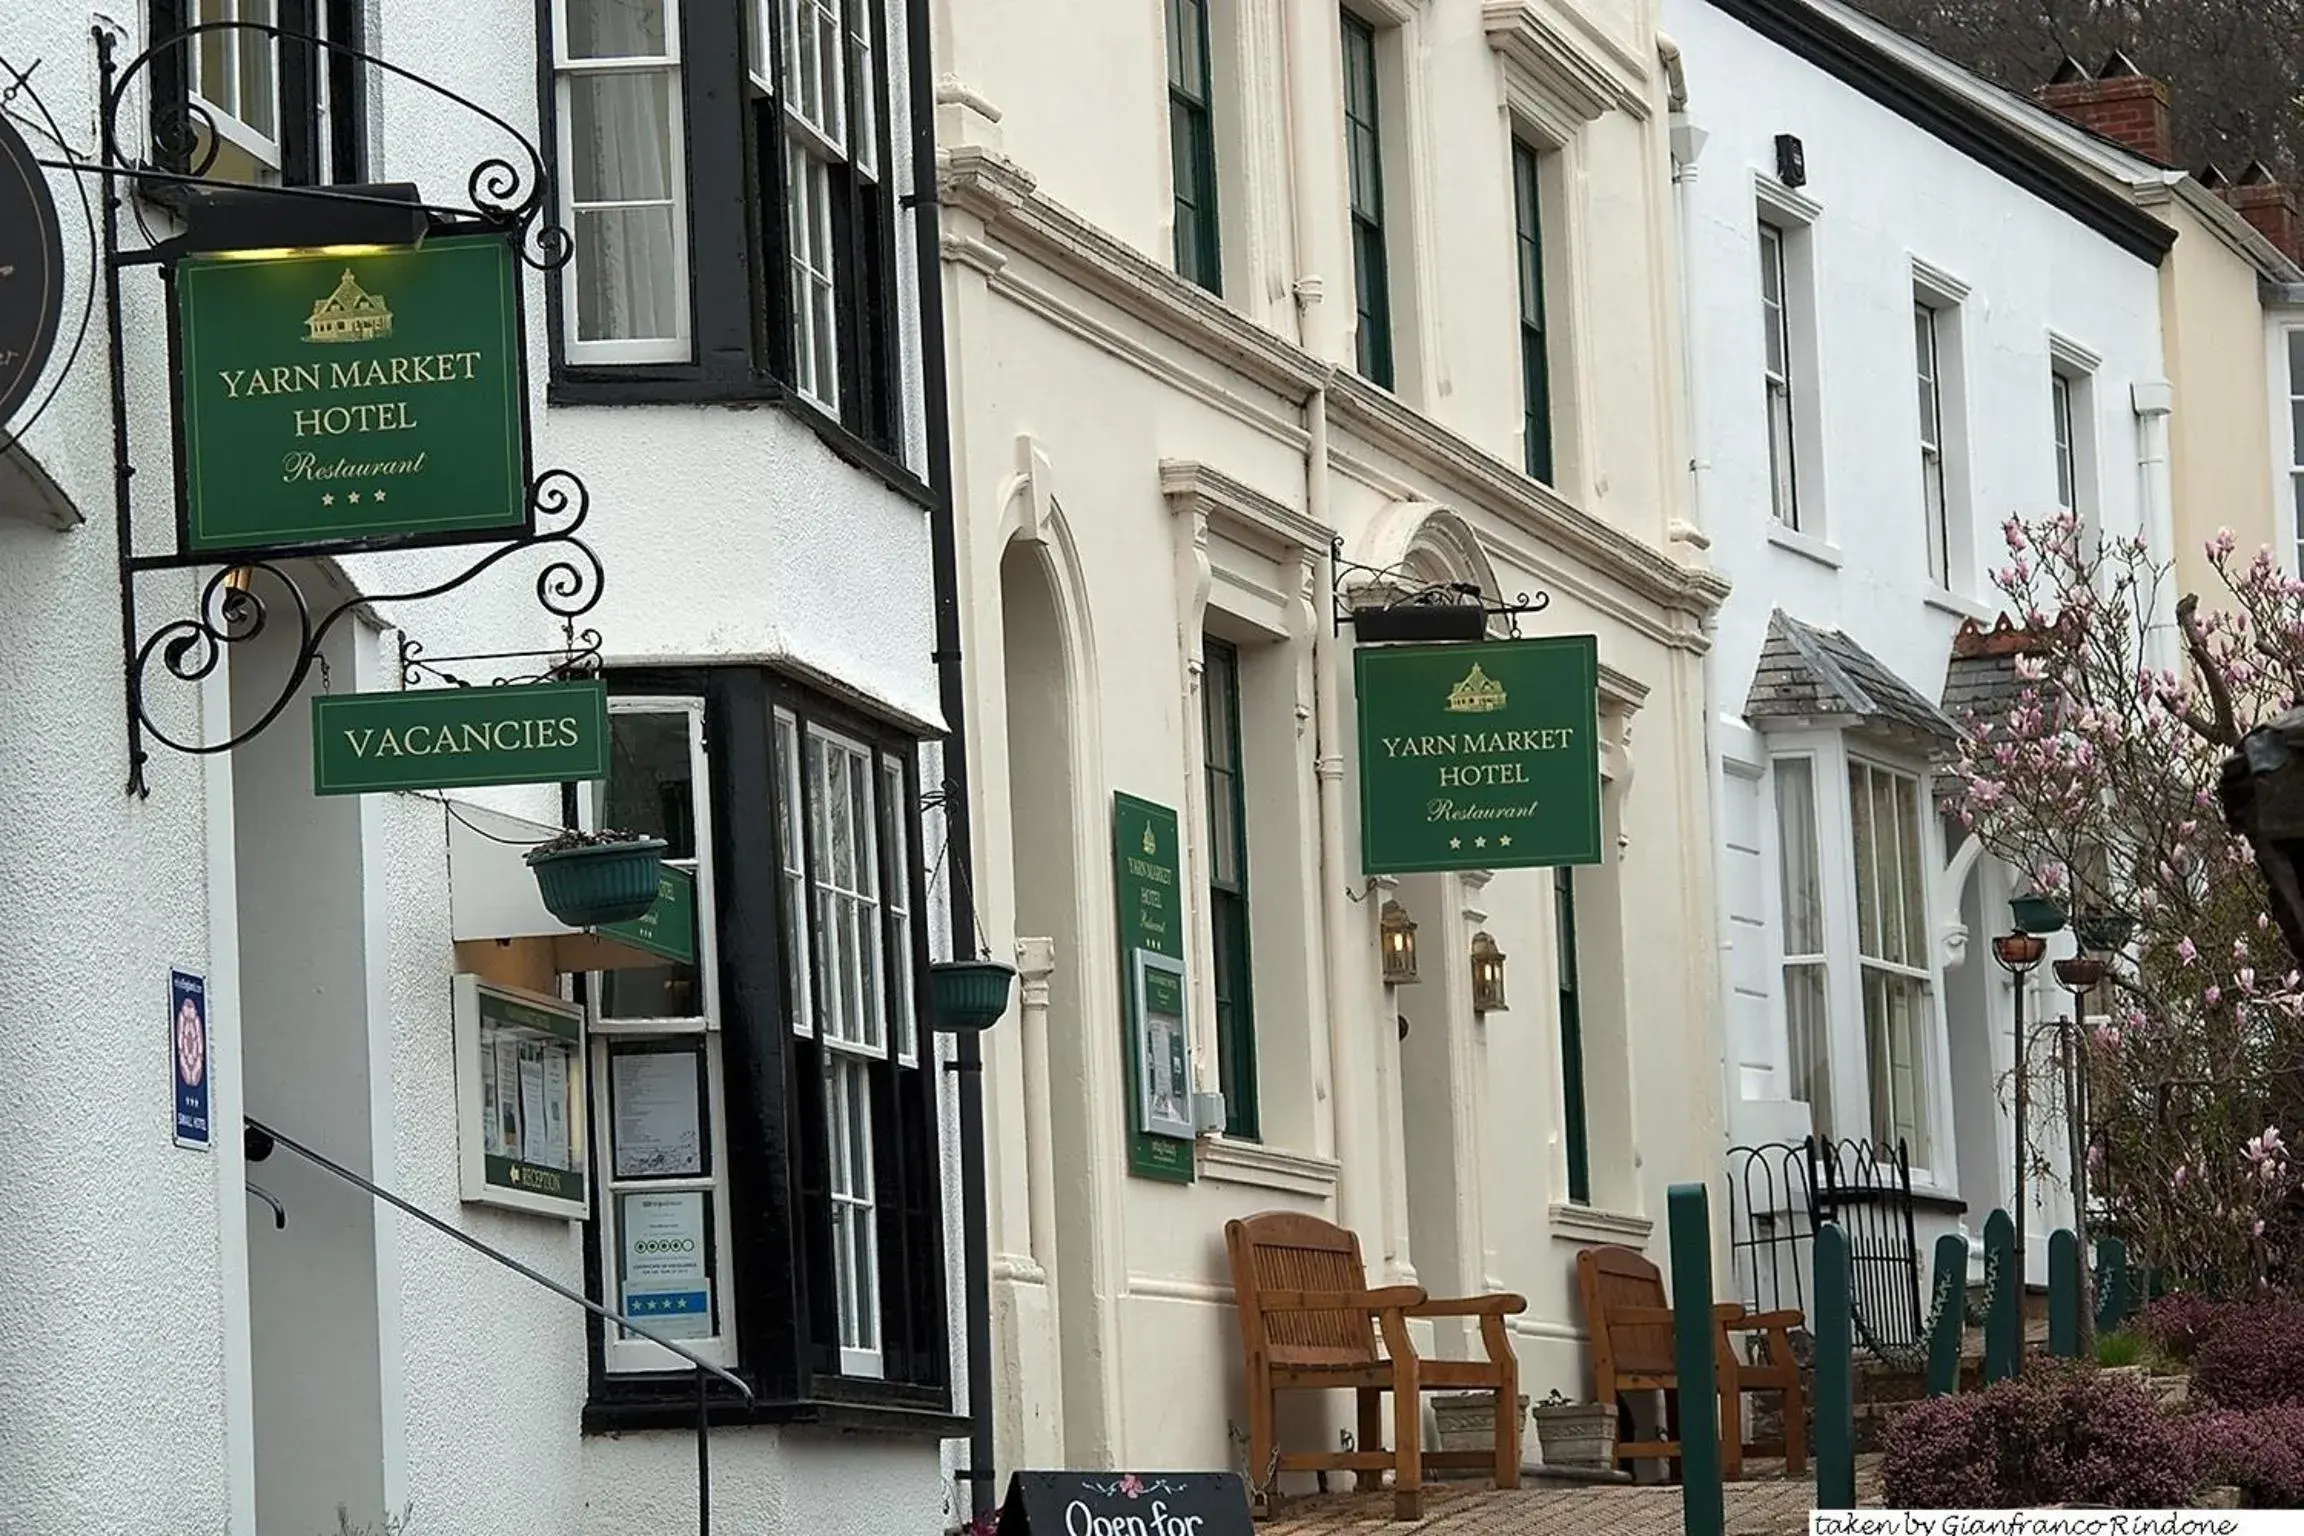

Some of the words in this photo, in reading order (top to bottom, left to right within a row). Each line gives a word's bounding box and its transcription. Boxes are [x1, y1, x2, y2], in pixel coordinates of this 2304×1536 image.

[219, 363, 321, 398] YARN
[330, 351, 482, 390] MARKET
[294, 402, 417, 437] HOTEL
[282, 451, 427, 483] Restaurant
[344, 718, 579, 759] VACANCIES
[1382, 735, 1457, 758] YARN
[1463, 728, 1574, 754] MARKET
[1440, 763, 1530, 787] HOTEL
[1426, 798, 1539, 822] Restaurant
[521, 1167, 562, 1193] RECEPTION
[1150, 1500, 1204, 1536] for
